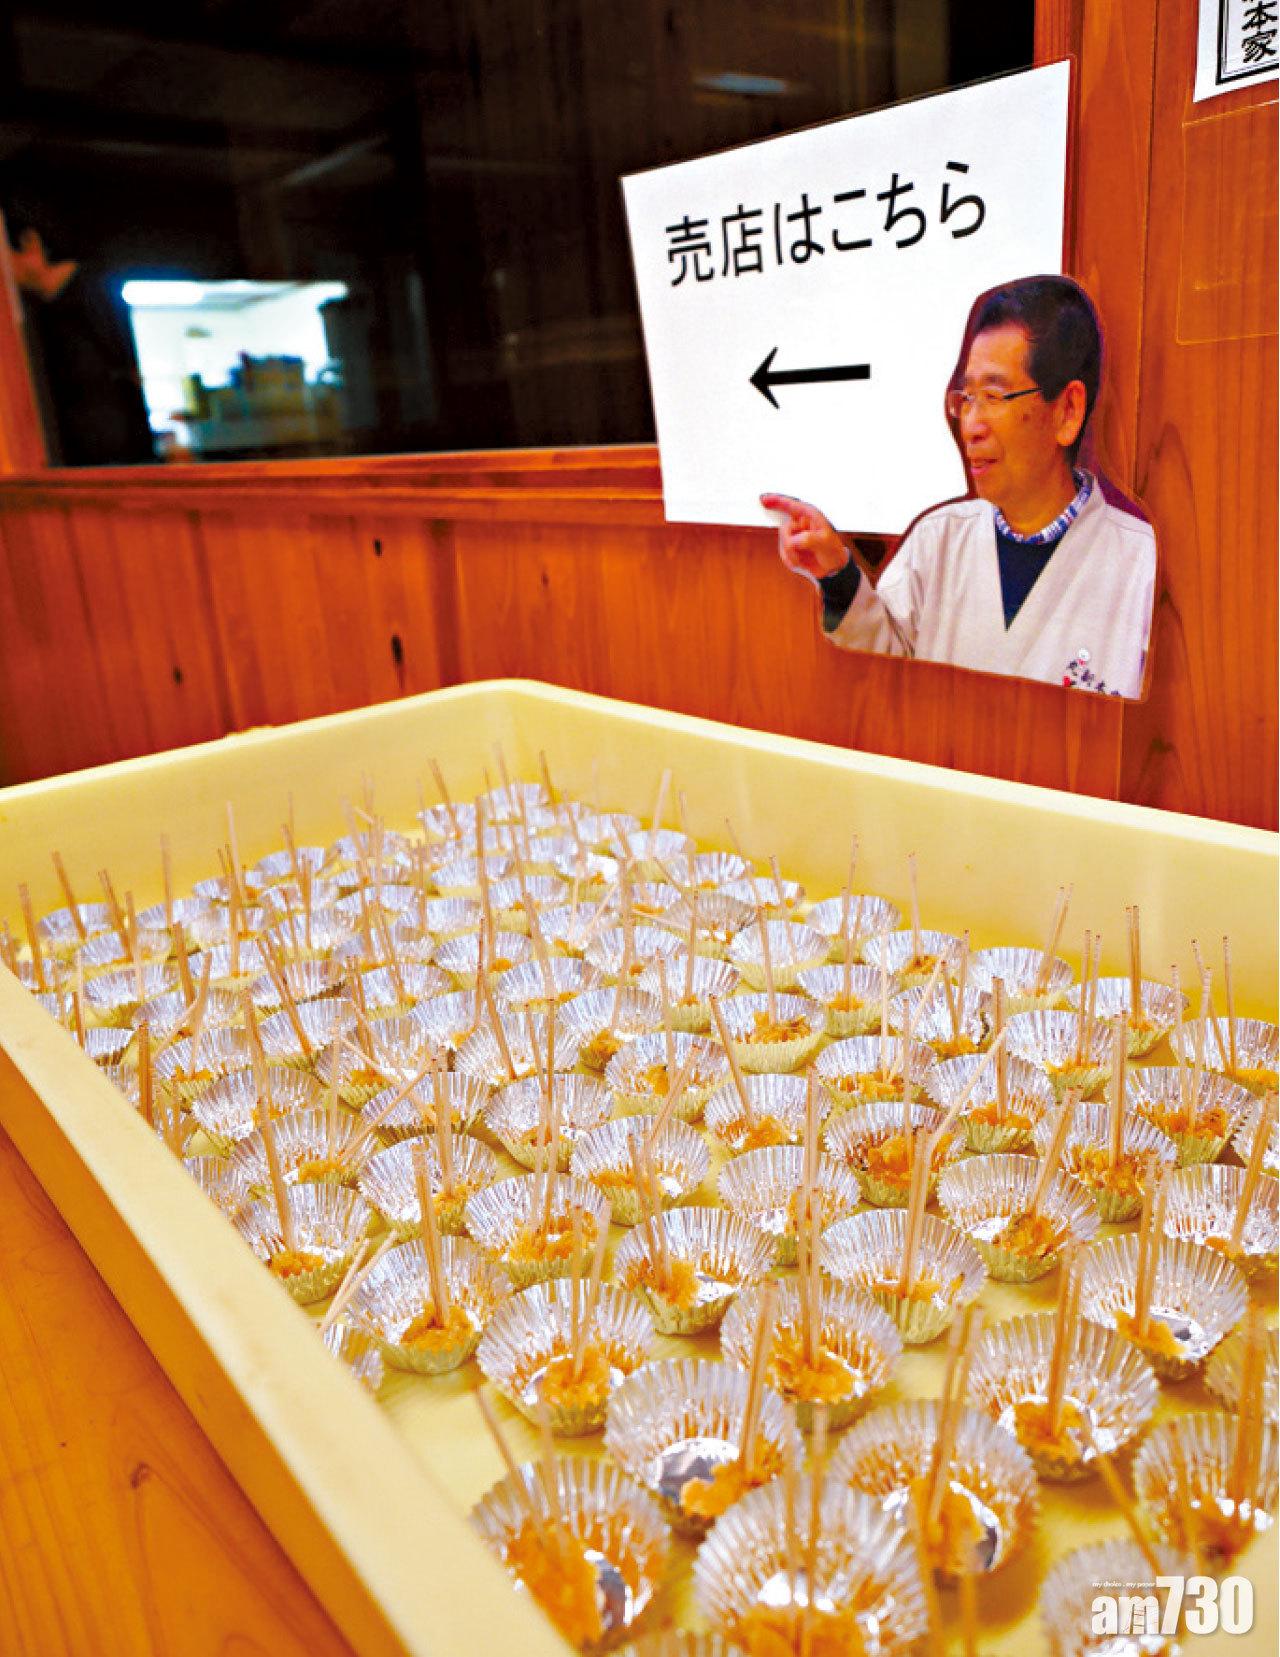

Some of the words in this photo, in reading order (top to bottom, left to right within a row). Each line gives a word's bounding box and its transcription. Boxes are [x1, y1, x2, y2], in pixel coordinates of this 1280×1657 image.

[1242, 0, 1277, 63] 本家
[665, 160, 987, 286] 売店はこちら
